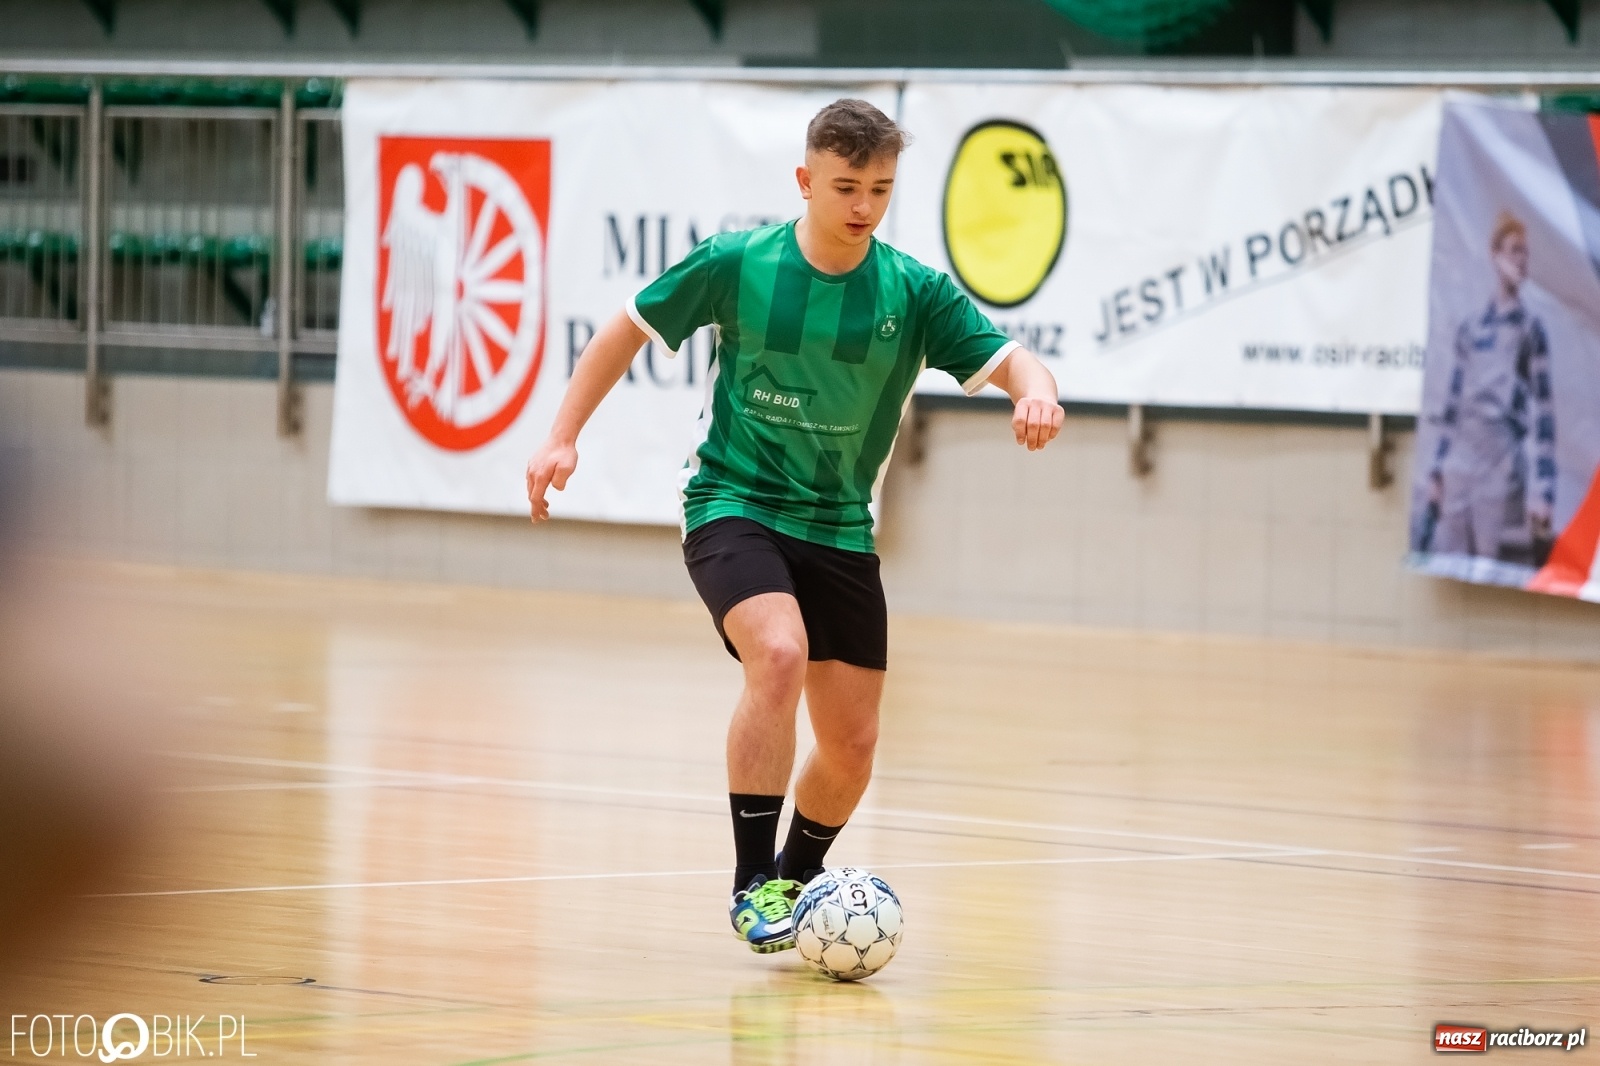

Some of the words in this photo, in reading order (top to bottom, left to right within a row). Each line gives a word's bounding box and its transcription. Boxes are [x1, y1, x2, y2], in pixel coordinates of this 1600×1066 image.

[1094, 265, 1186, 343] JEST
[1199, 244, 1232, 296] W
[753, 389, 771, 402] RH
[773, 394, 800, 408] BUD
